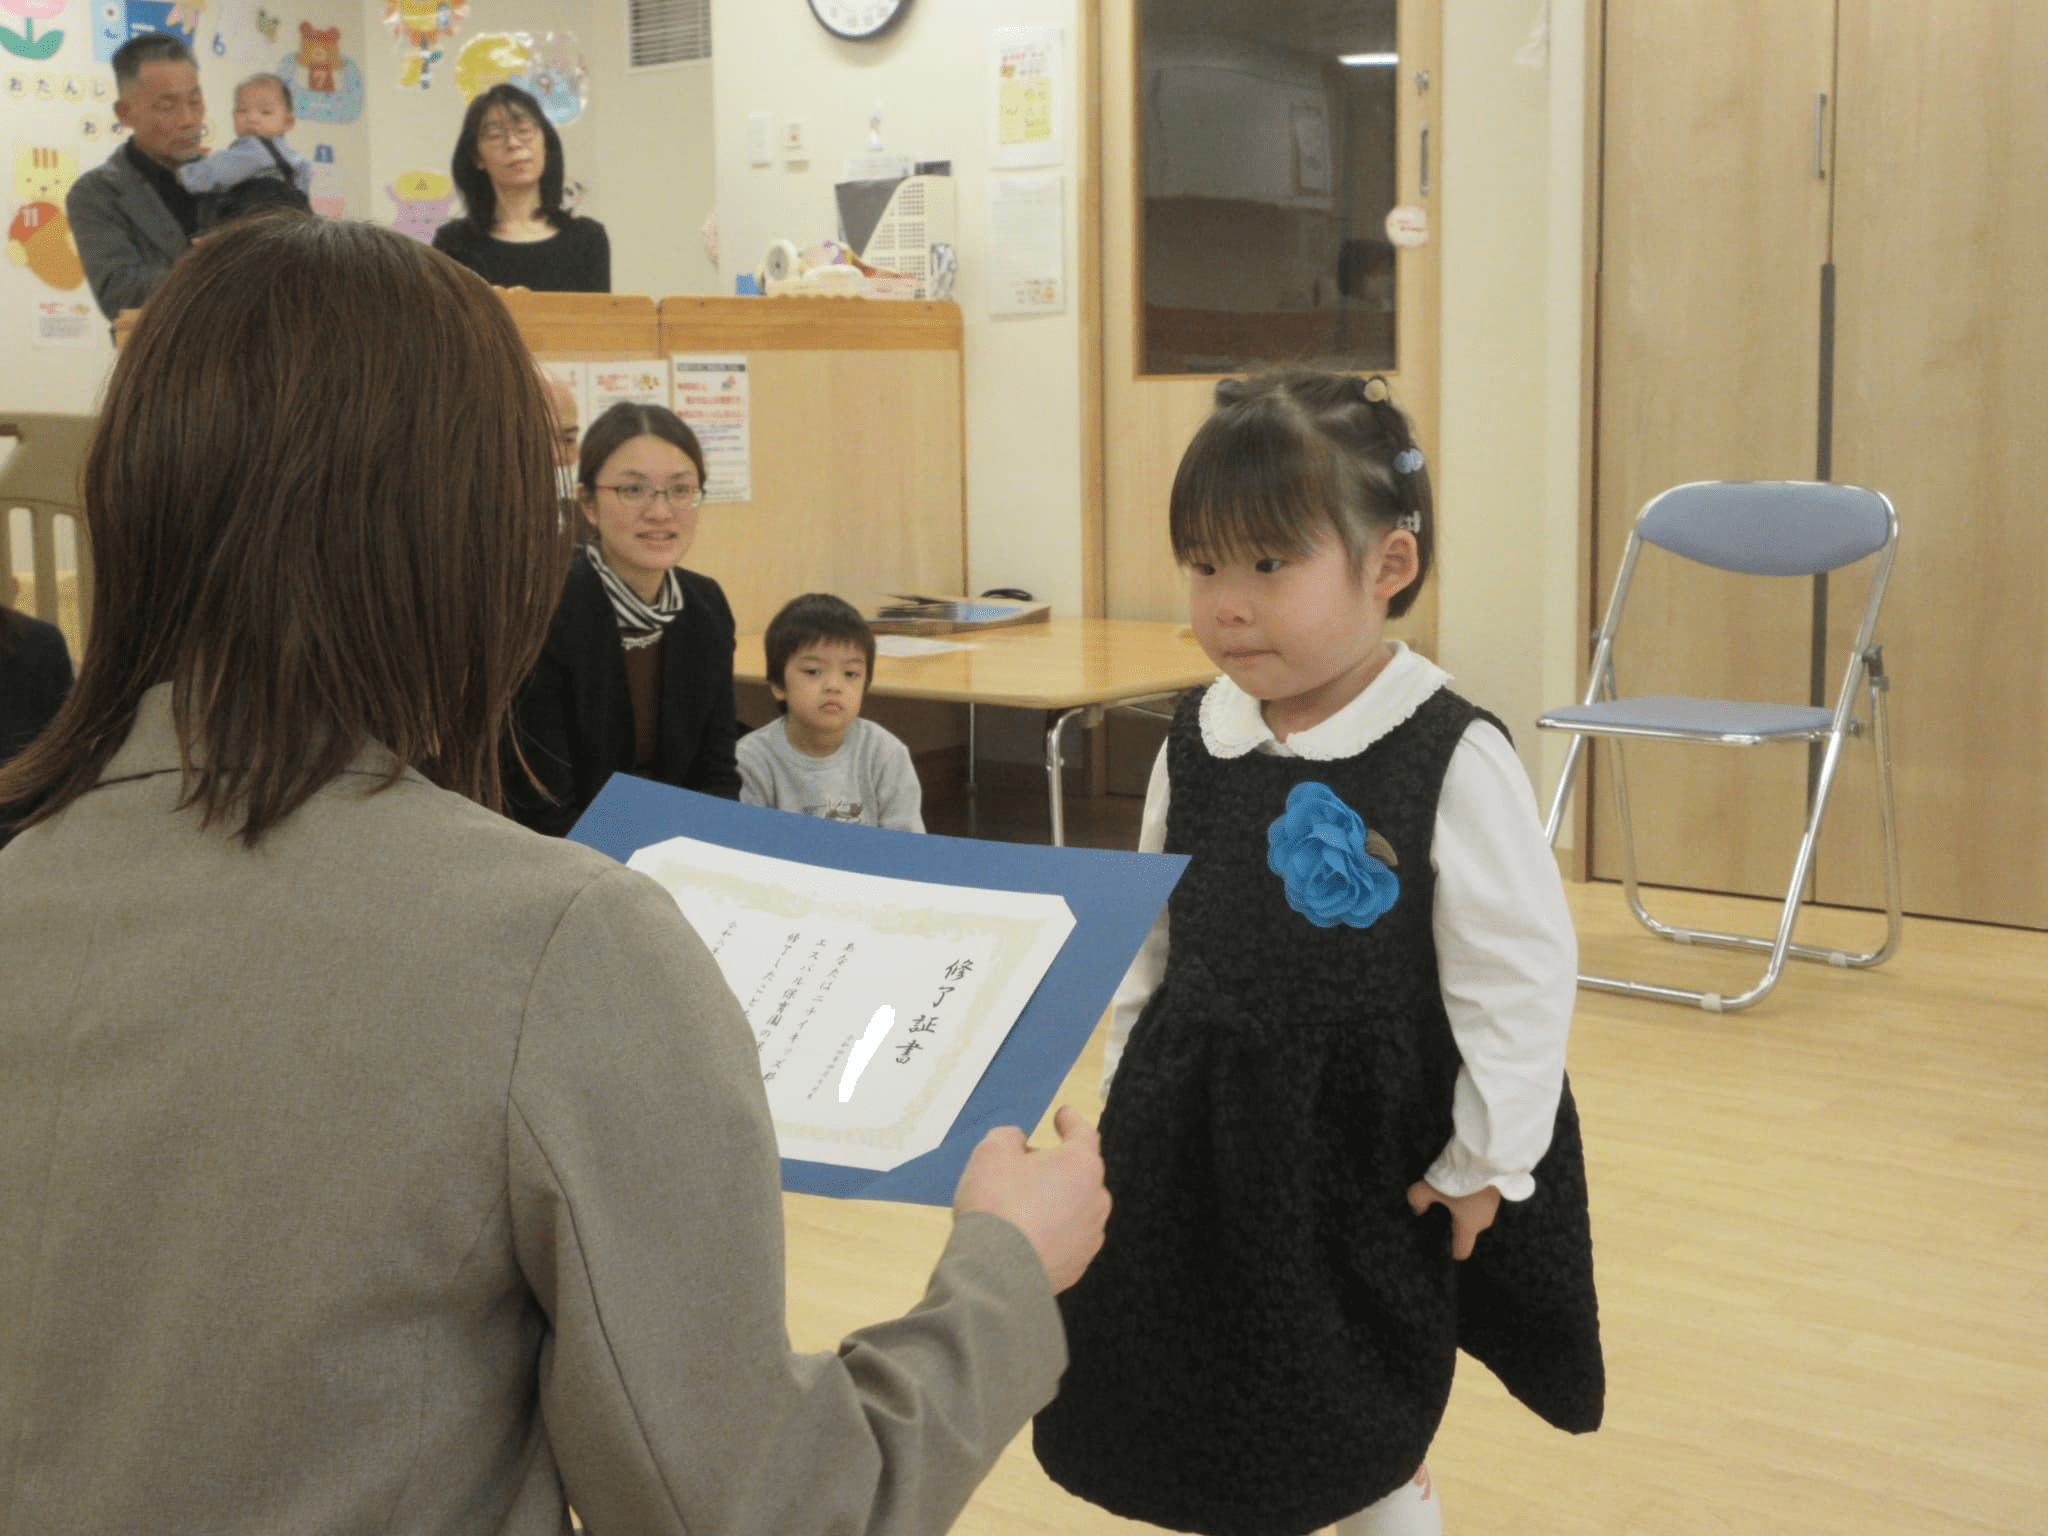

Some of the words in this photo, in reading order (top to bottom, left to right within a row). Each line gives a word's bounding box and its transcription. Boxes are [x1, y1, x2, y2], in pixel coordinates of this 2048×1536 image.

[212, 32, 226, 57] 6
[536, 73, 553, 95] 9
[24, 207, 39, 228] 11
[895, 958, 974, 1065] 修了証書
